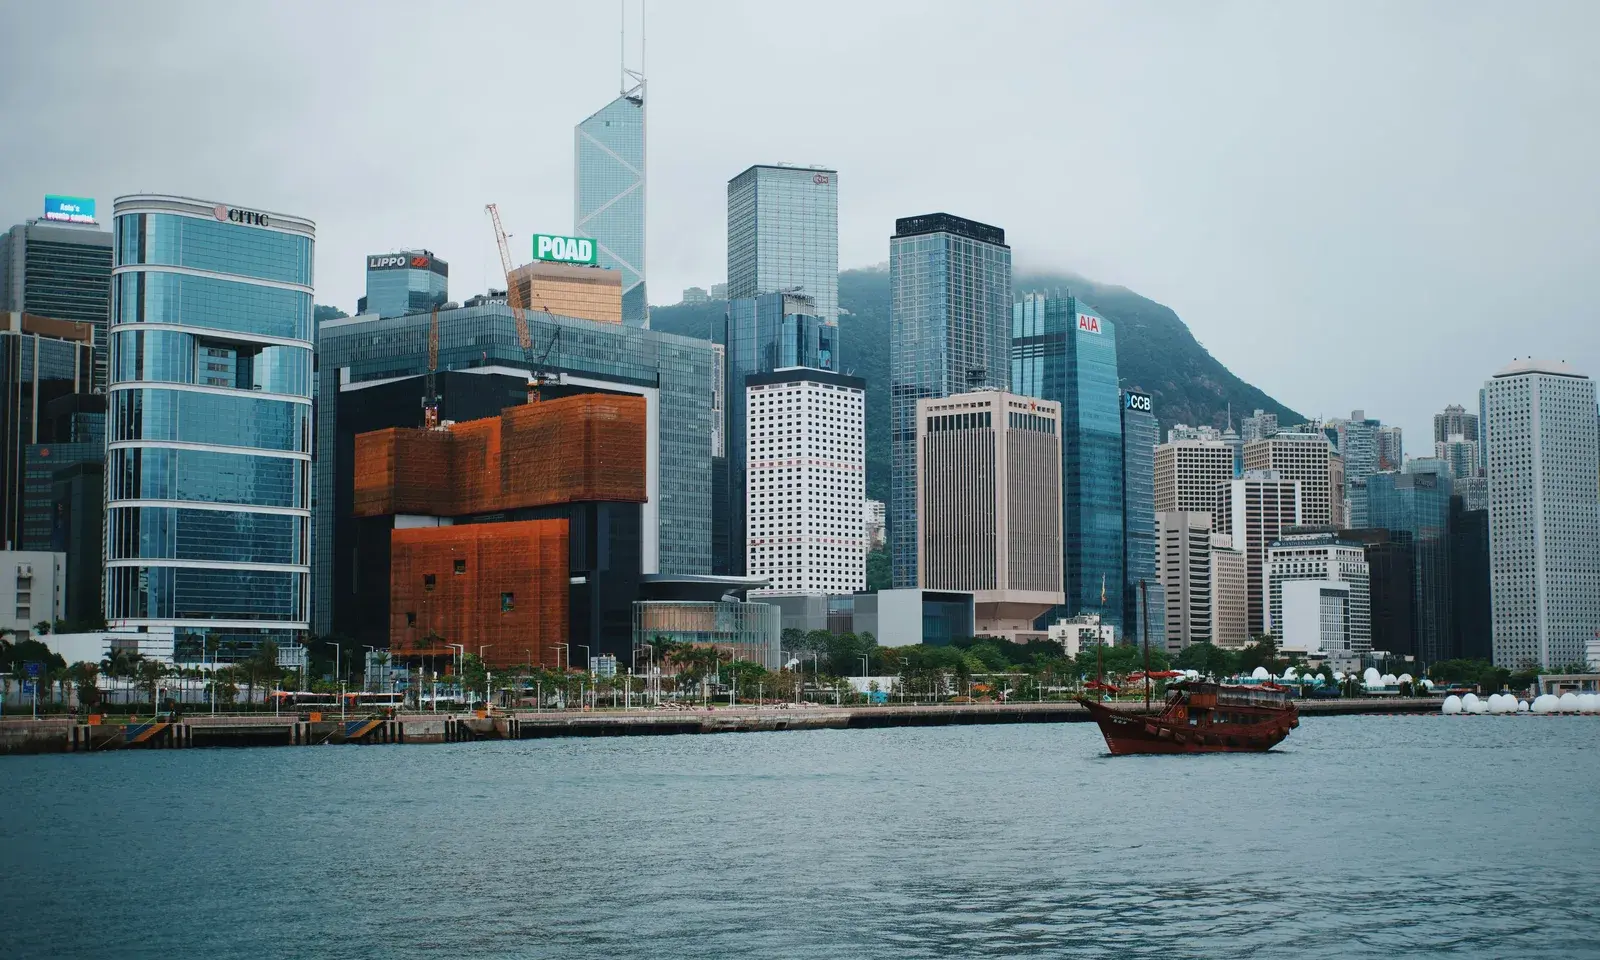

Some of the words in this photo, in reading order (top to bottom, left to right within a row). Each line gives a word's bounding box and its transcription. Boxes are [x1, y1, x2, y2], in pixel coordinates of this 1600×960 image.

[228, 208, 269, 227] CITIC
[538, 235, 592, 262] POAD
[370, 256, 406, 268] LIPPO
[1079, 315, 1099, 333] AIA
[1130, 394, 1151, 411] CCB
